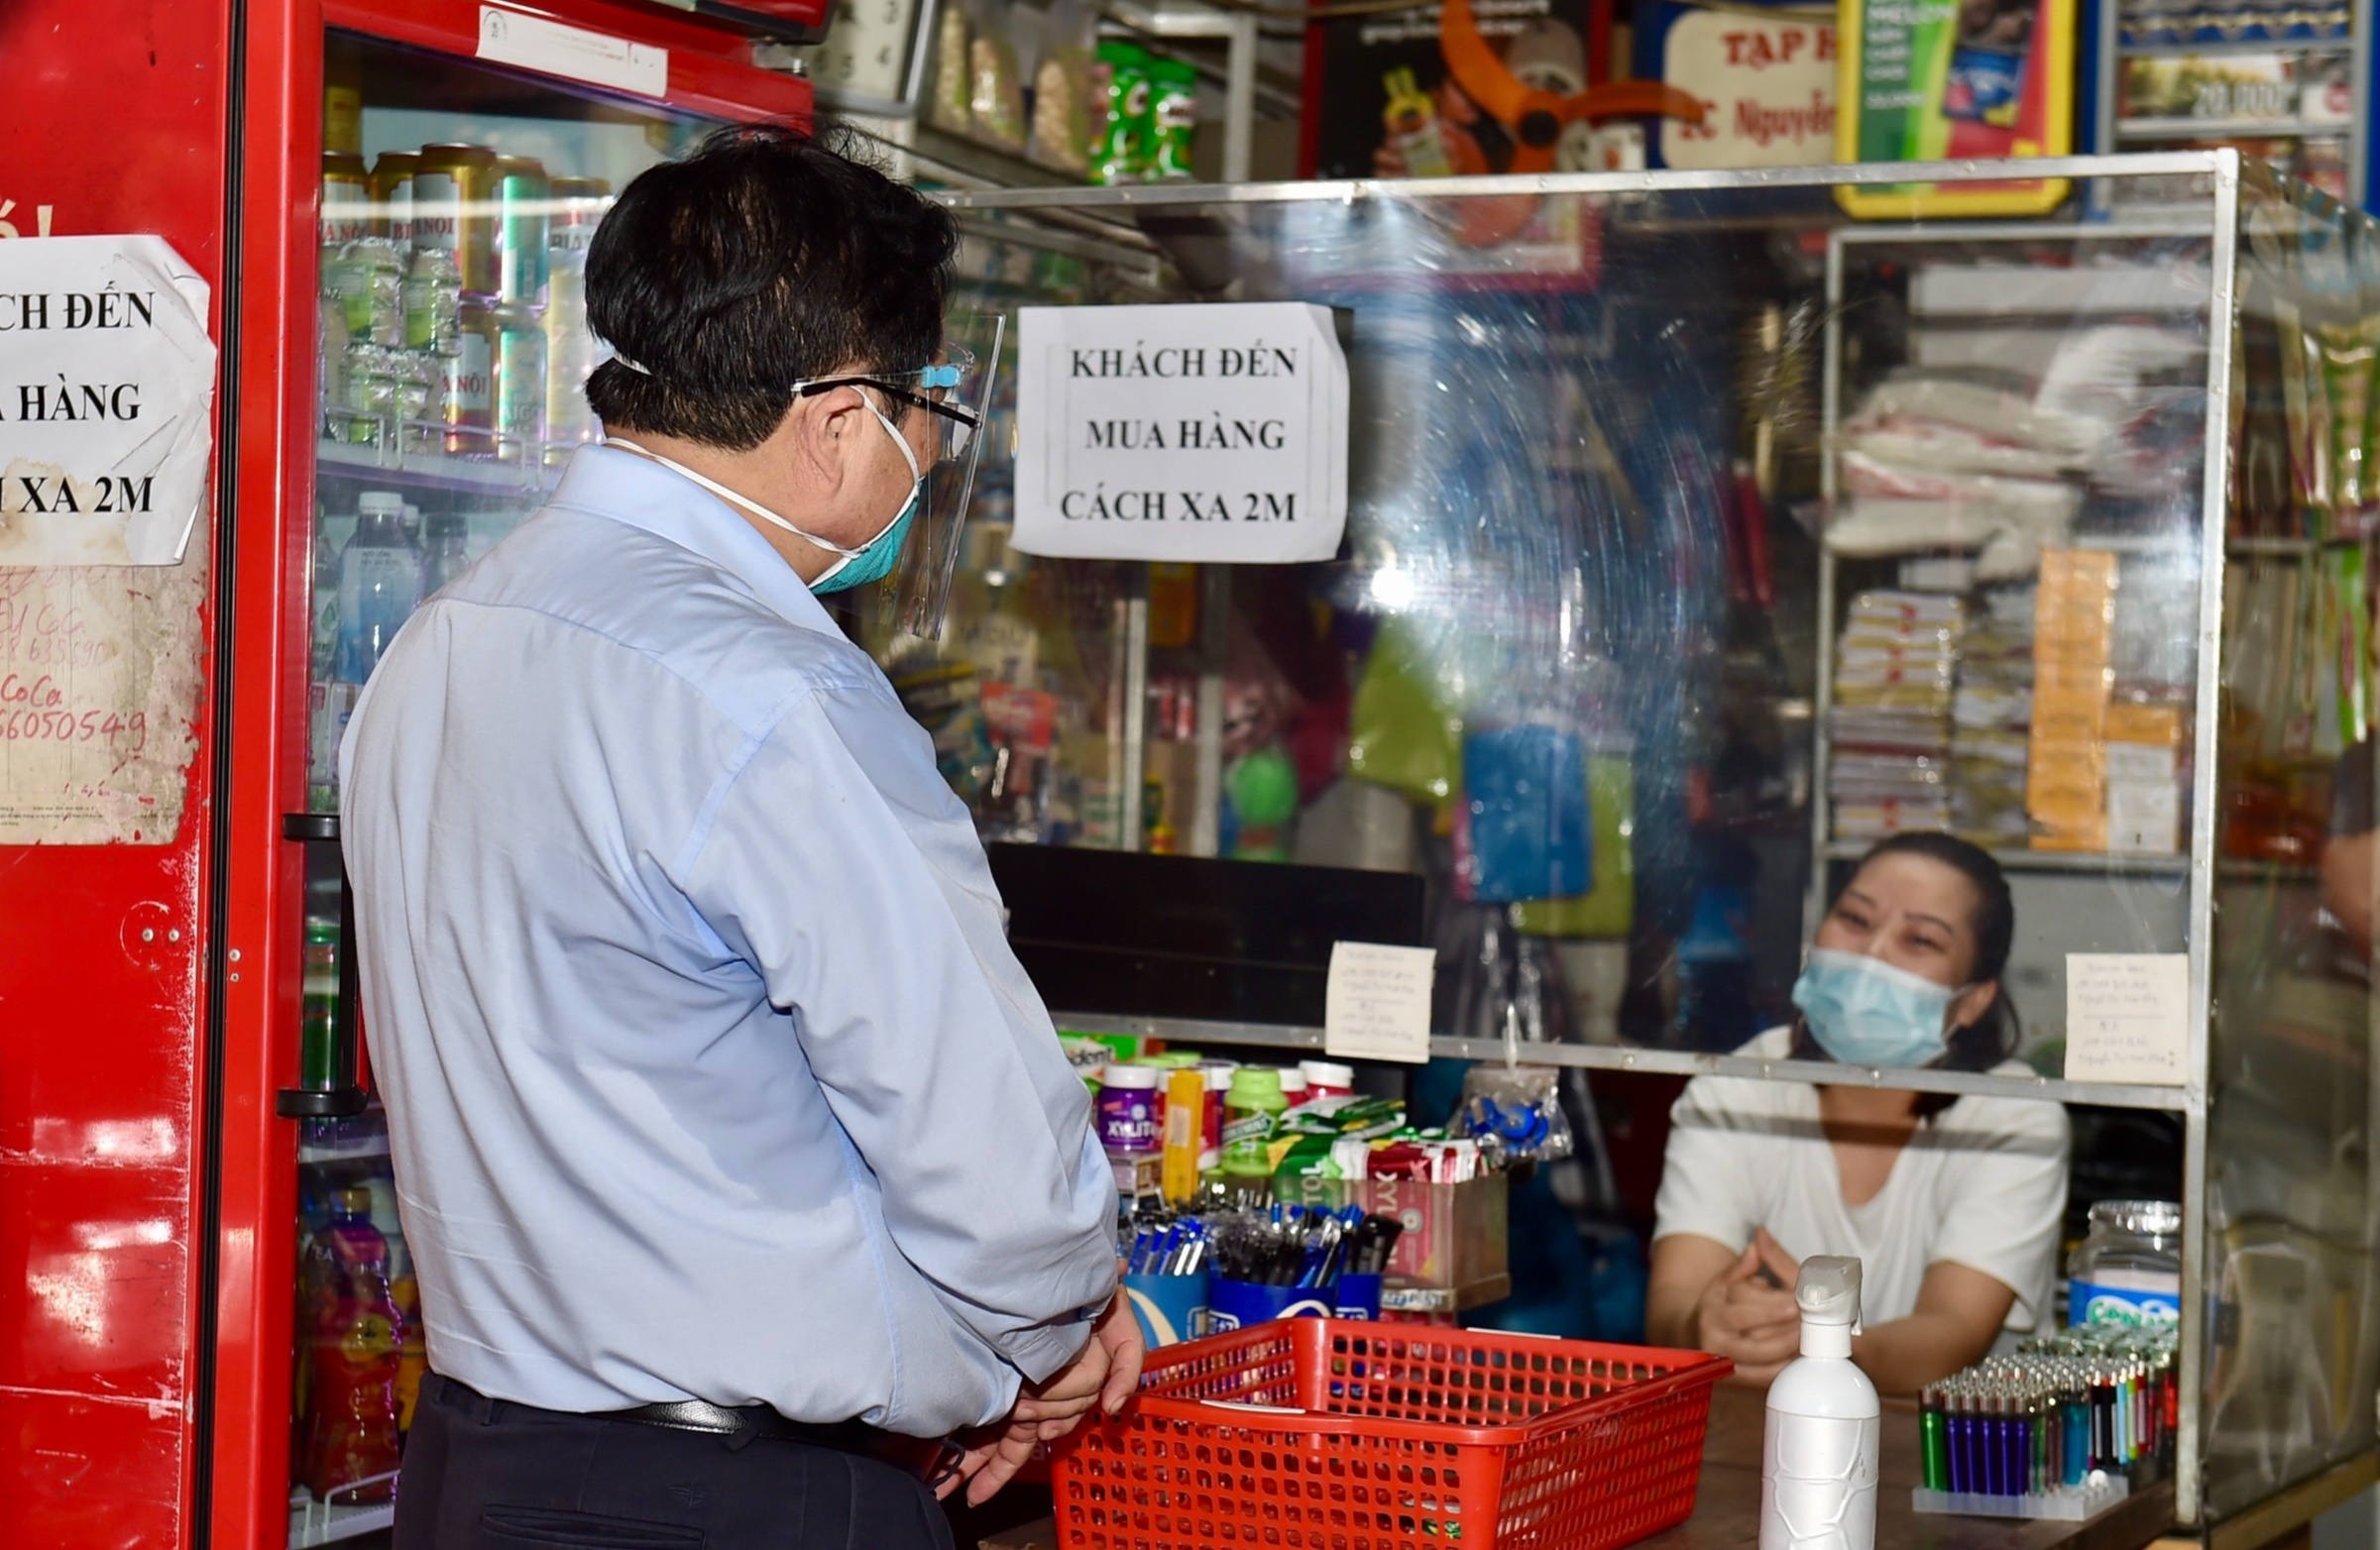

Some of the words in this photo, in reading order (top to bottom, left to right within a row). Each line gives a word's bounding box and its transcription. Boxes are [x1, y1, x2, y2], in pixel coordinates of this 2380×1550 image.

[62, 280, 156, 330] ĐẾN
[1071, 340, 1206, 378] KHÁCH
[1217, 338, 1299, 377] ĐẾN
[17, 373, 142, 421] HÀNG
[1085, 420, 1167, 449] MUA
[1178, 410, 1286, 449] HÀNG
[18, 476, 81, 513] XA
[93, 476, 156, 513] 2M
[1060, 482, 1167, 521] CÁCH
[1179, 493, 1231, 521] XA
[1242, 493, 1298, 521] 2M
